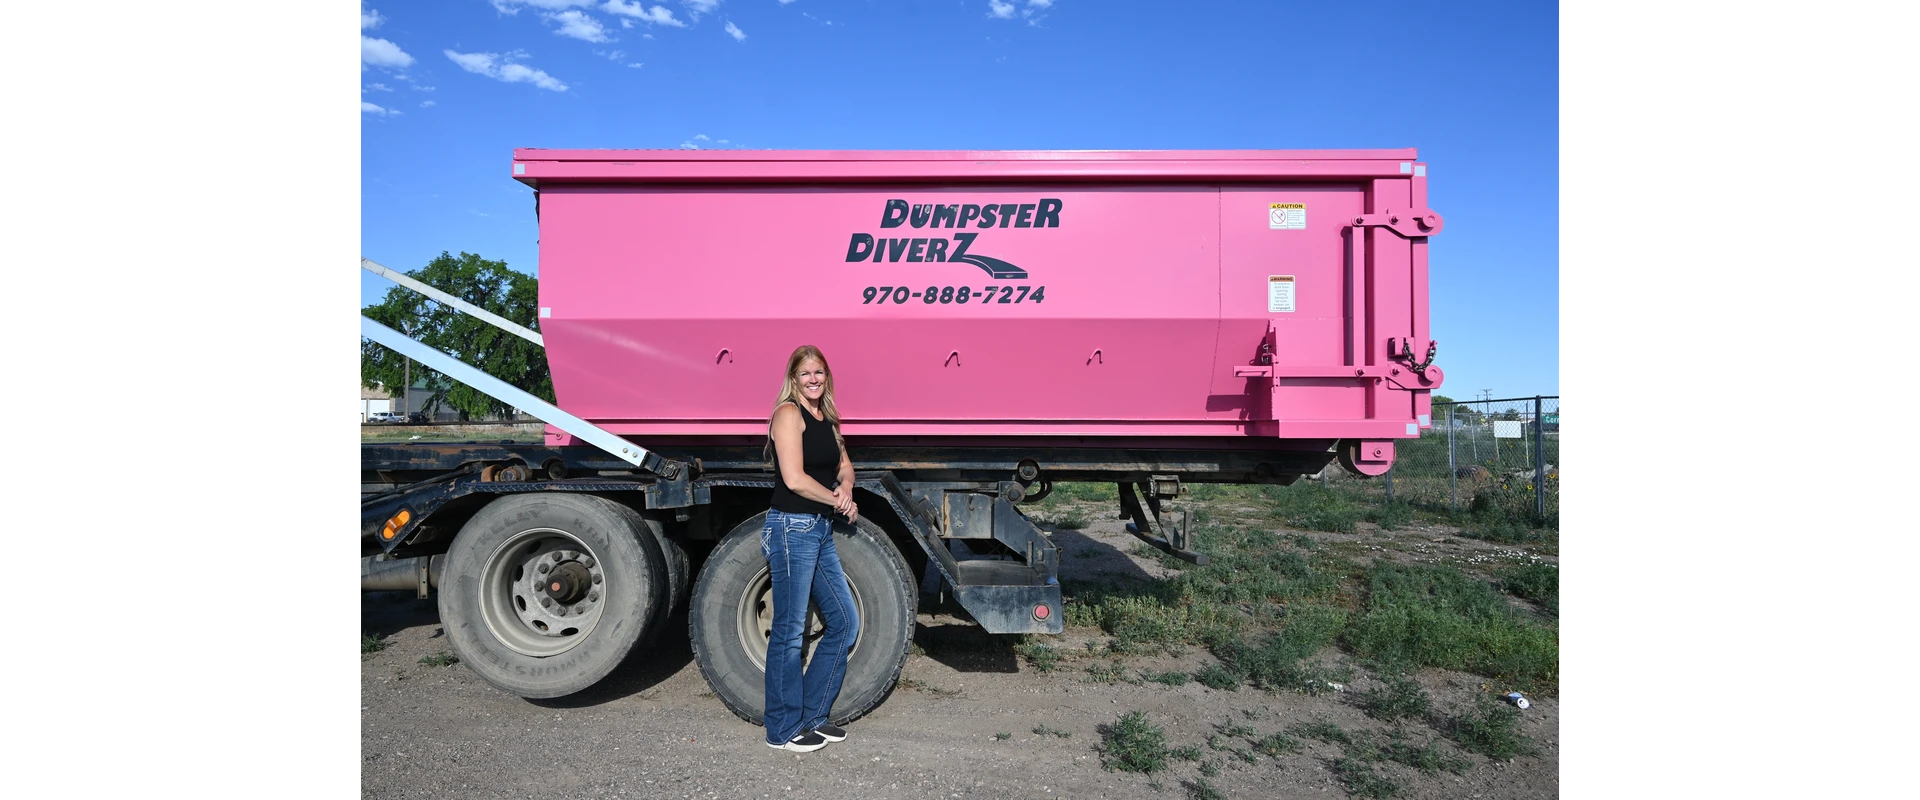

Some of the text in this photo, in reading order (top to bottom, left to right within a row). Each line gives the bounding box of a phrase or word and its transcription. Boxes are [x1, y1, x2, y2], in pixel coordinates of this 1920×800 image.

[880, 198, 1063, 229] DUMPSTER
[845, 232, 979, 263] DIVERZ
[862, 286, 1045, 305] 970-888-7274
